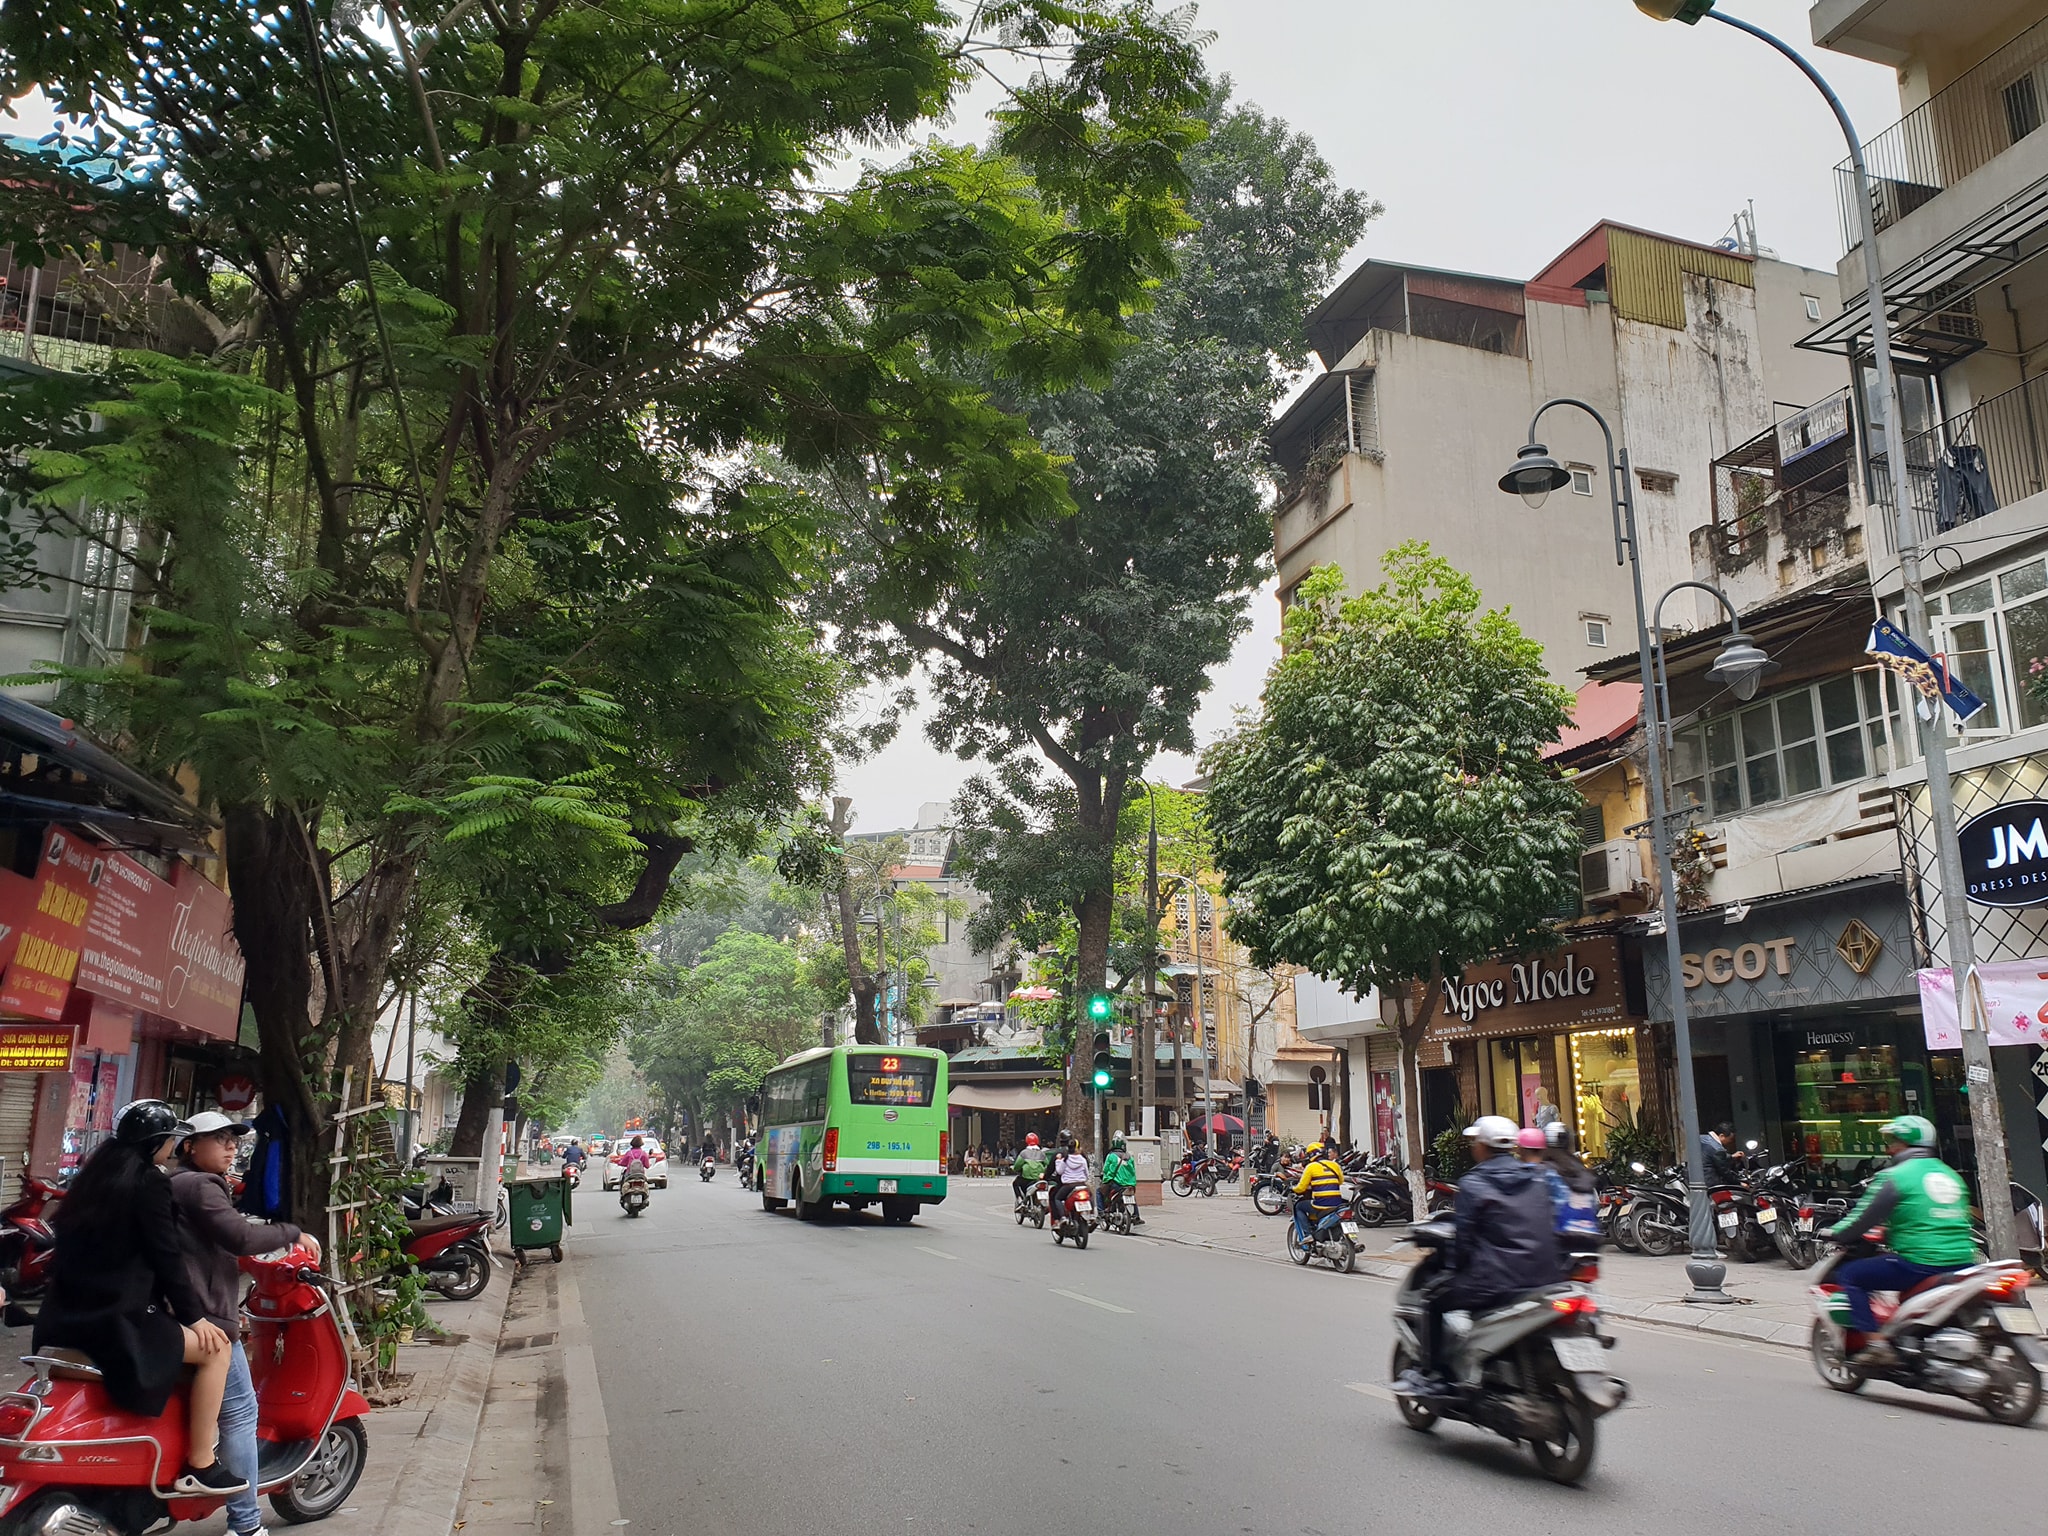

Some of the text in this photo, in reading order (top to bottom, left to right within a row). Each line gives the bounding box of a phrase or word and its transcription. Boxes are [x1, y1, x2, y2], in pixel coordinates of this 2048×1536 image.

[1986, 817, 2048, 869] JM
[1970, 871, 2048, 894] DRESS DES
[1681, 936, 1796, 988] SCOT
[1441, 954, 1595, 1023] Ngoc Mode
[1806, 1031, 1855, 1045] Hennessy
[30, 1059, 44, 1067] 377
[45, 1059, 64, 1067] 0216
[883, 1057, 899, 1071] 23
[866, 1141, 881, 1150] 29B
[887, 1141, 911, 1151] 195.14
